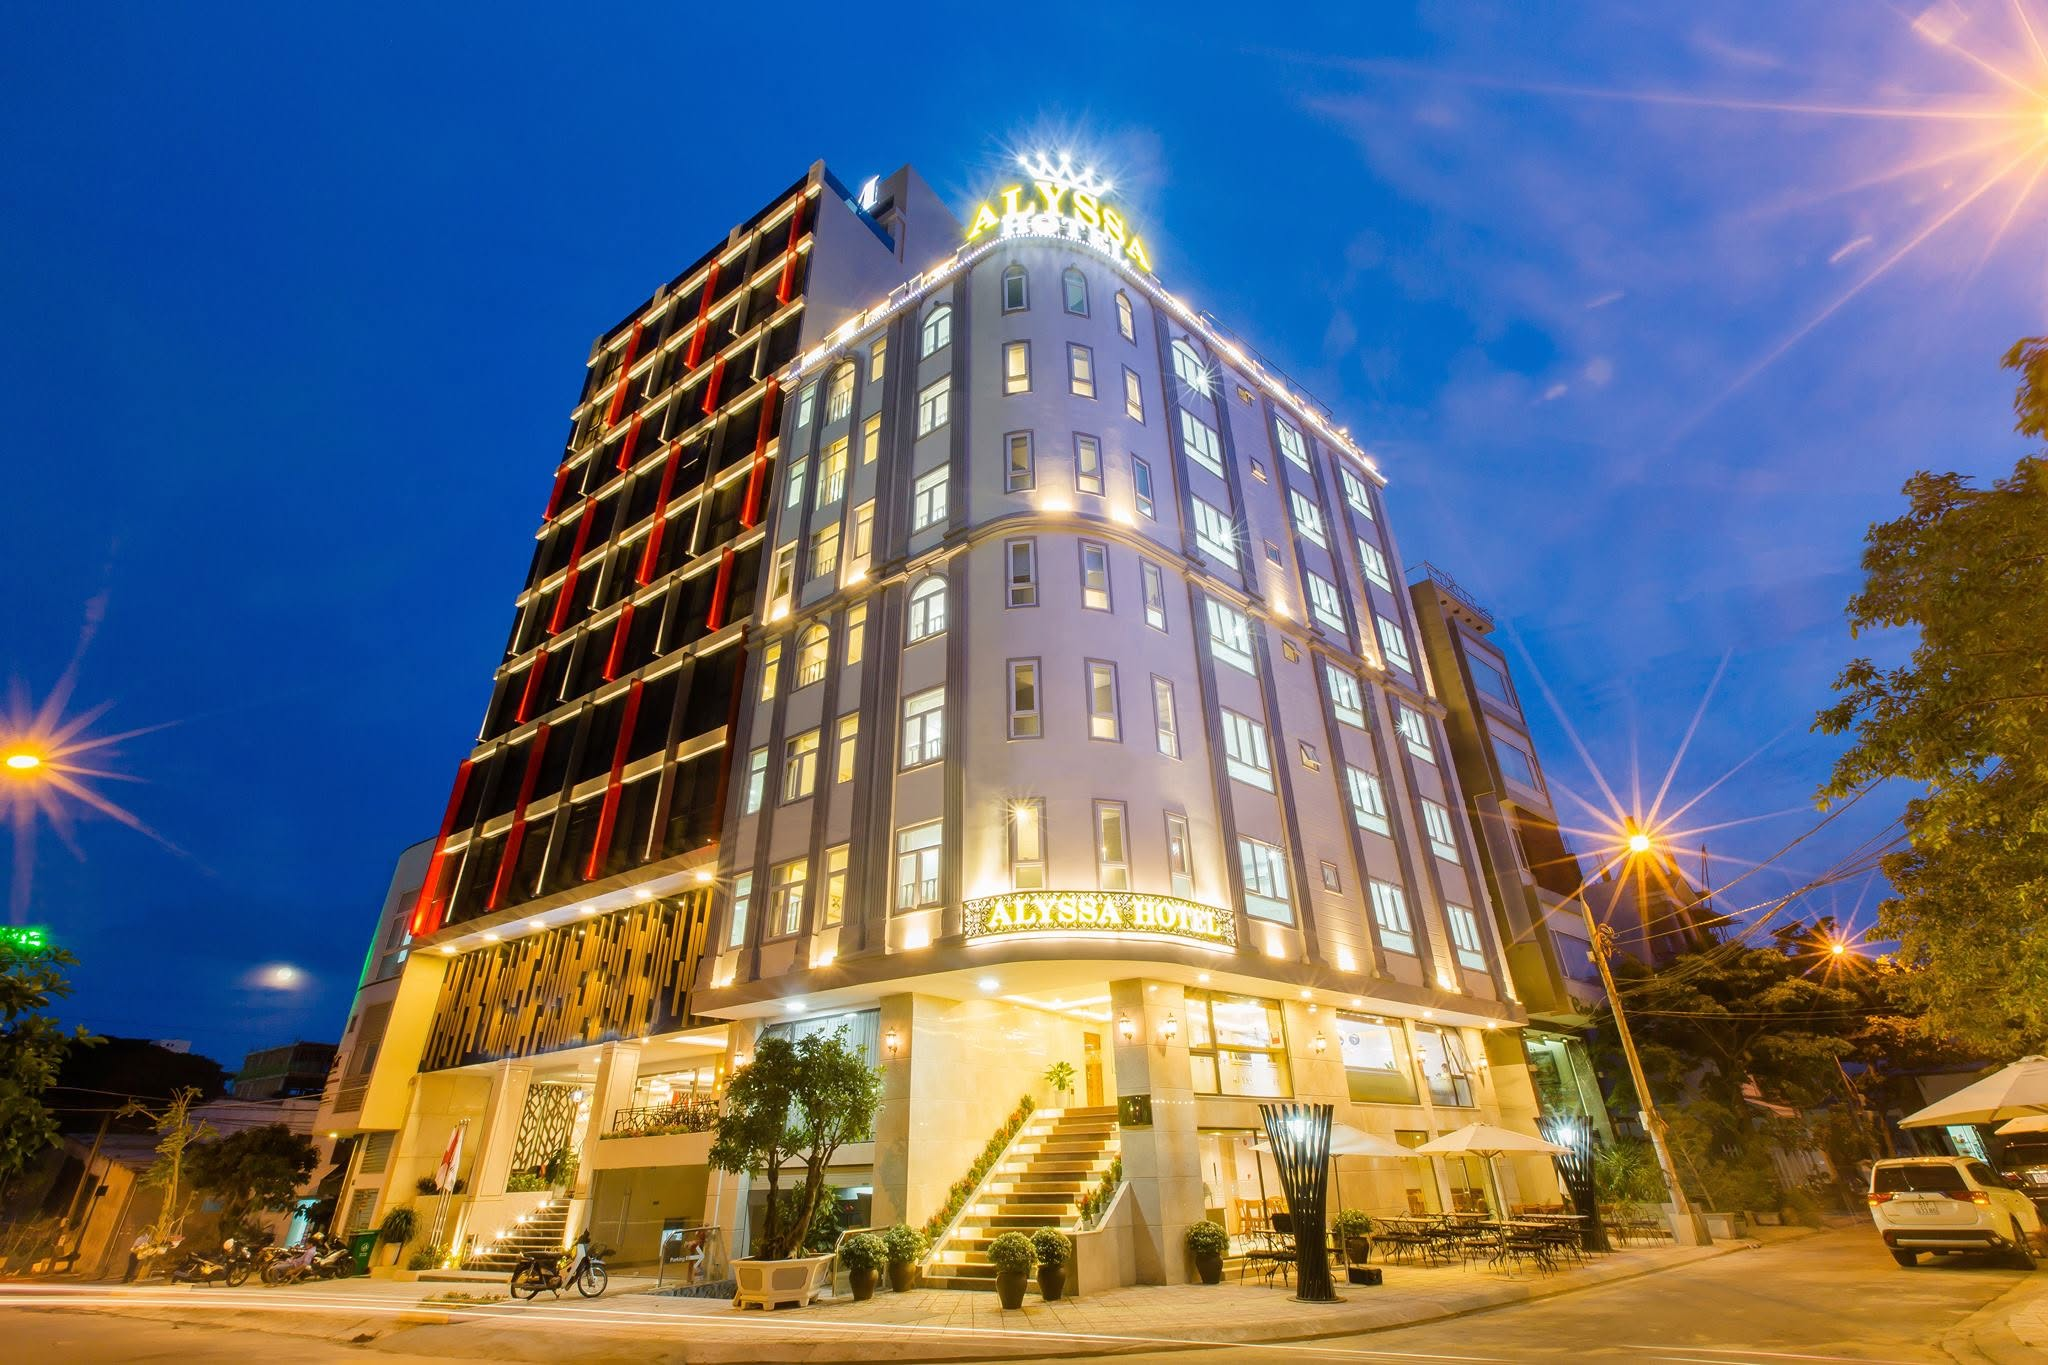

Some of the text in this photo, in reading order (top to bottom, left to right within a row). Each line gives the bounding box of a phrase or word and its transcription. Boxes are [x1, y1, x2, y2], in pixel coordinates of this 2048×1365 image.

[967, 181, 1151, 271] ALYSSA
[990, 898, 1220, 936] ALYSSA HOTEL
